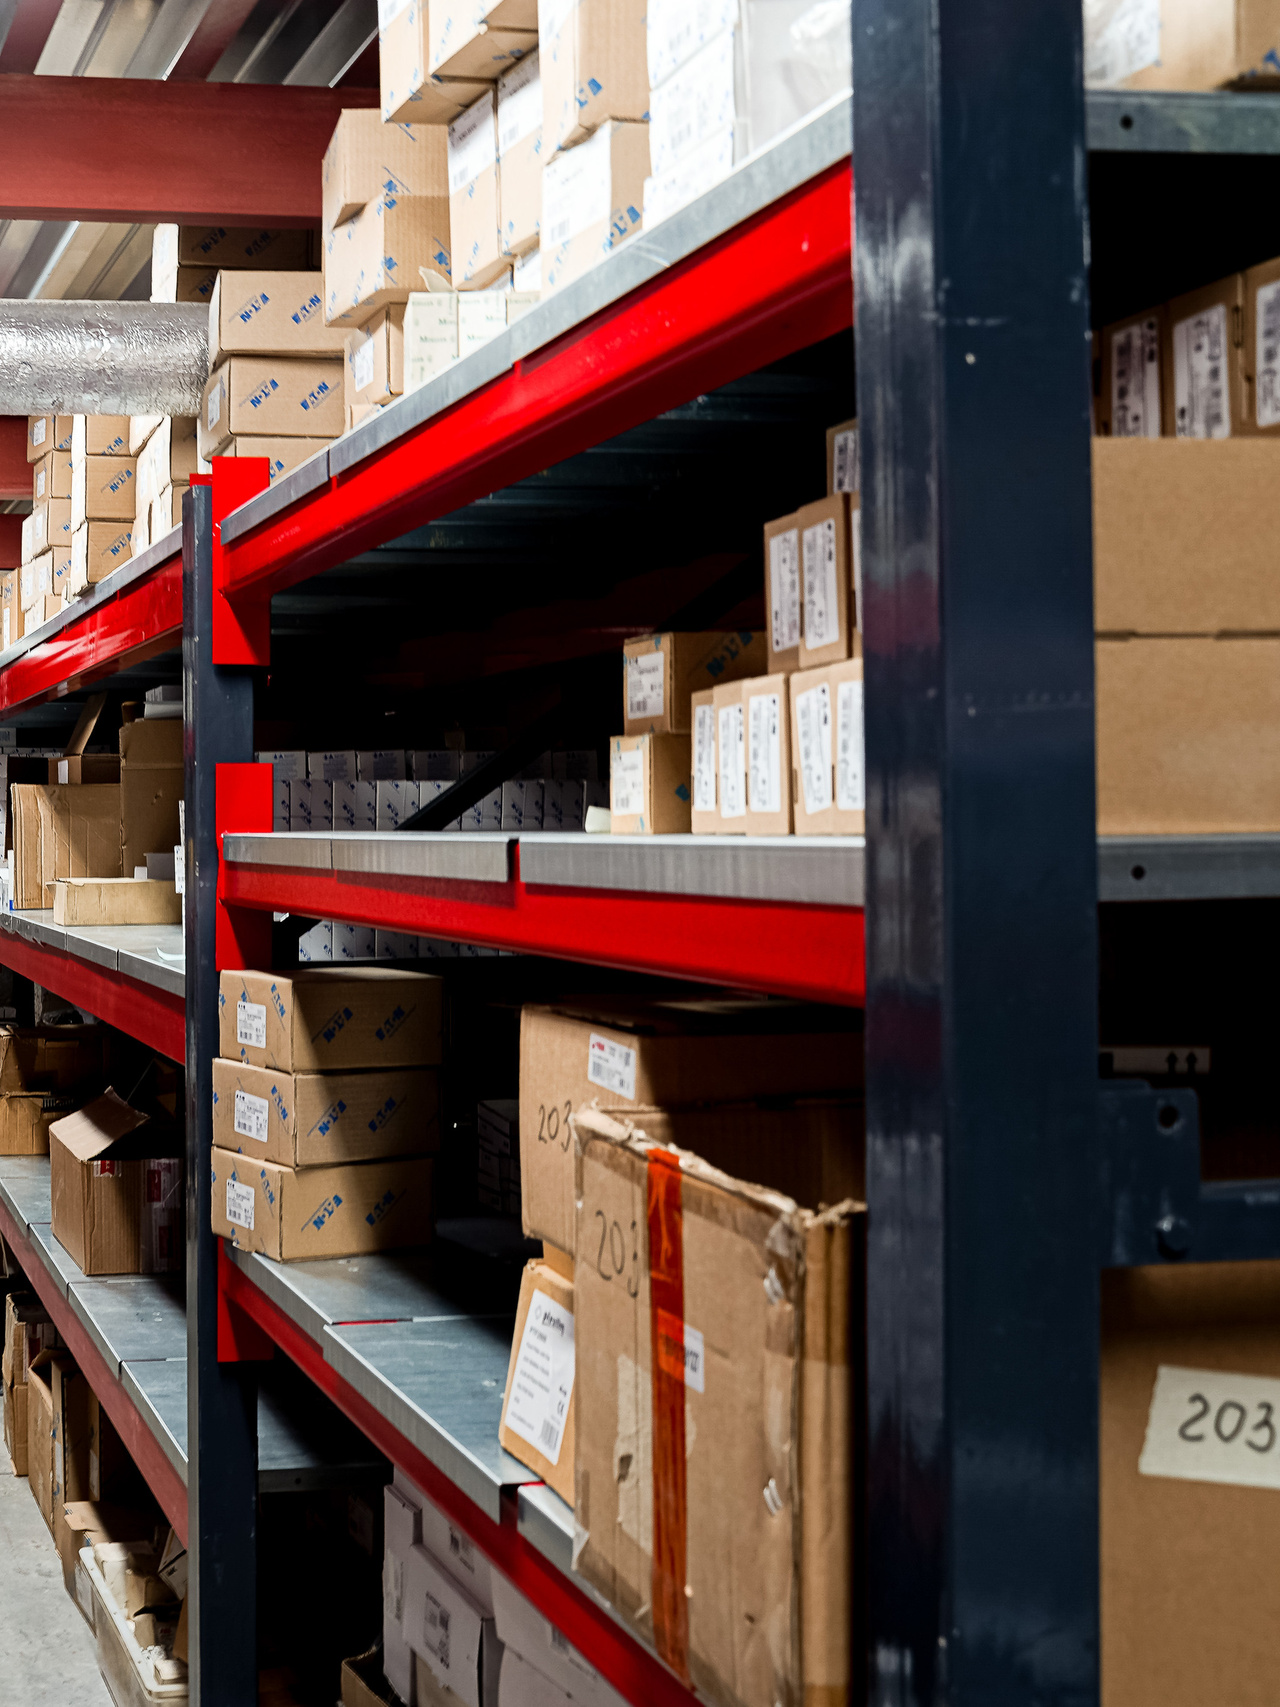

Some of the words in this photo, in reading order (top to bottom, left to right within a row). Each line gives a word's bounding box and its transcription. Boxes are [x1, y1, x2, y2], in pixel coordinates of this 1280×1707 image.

[239, 293, 270, 323] EATON
[291, 294, 321, 324] EATON
[249, 379, 279, 409] EATON
[300, 381, 330, 411] EATON
[537, 1100, 572, 1152] 203
[595, 1210, 639, 1299] 203
[1178, 1392, 1277, 1454] 203
